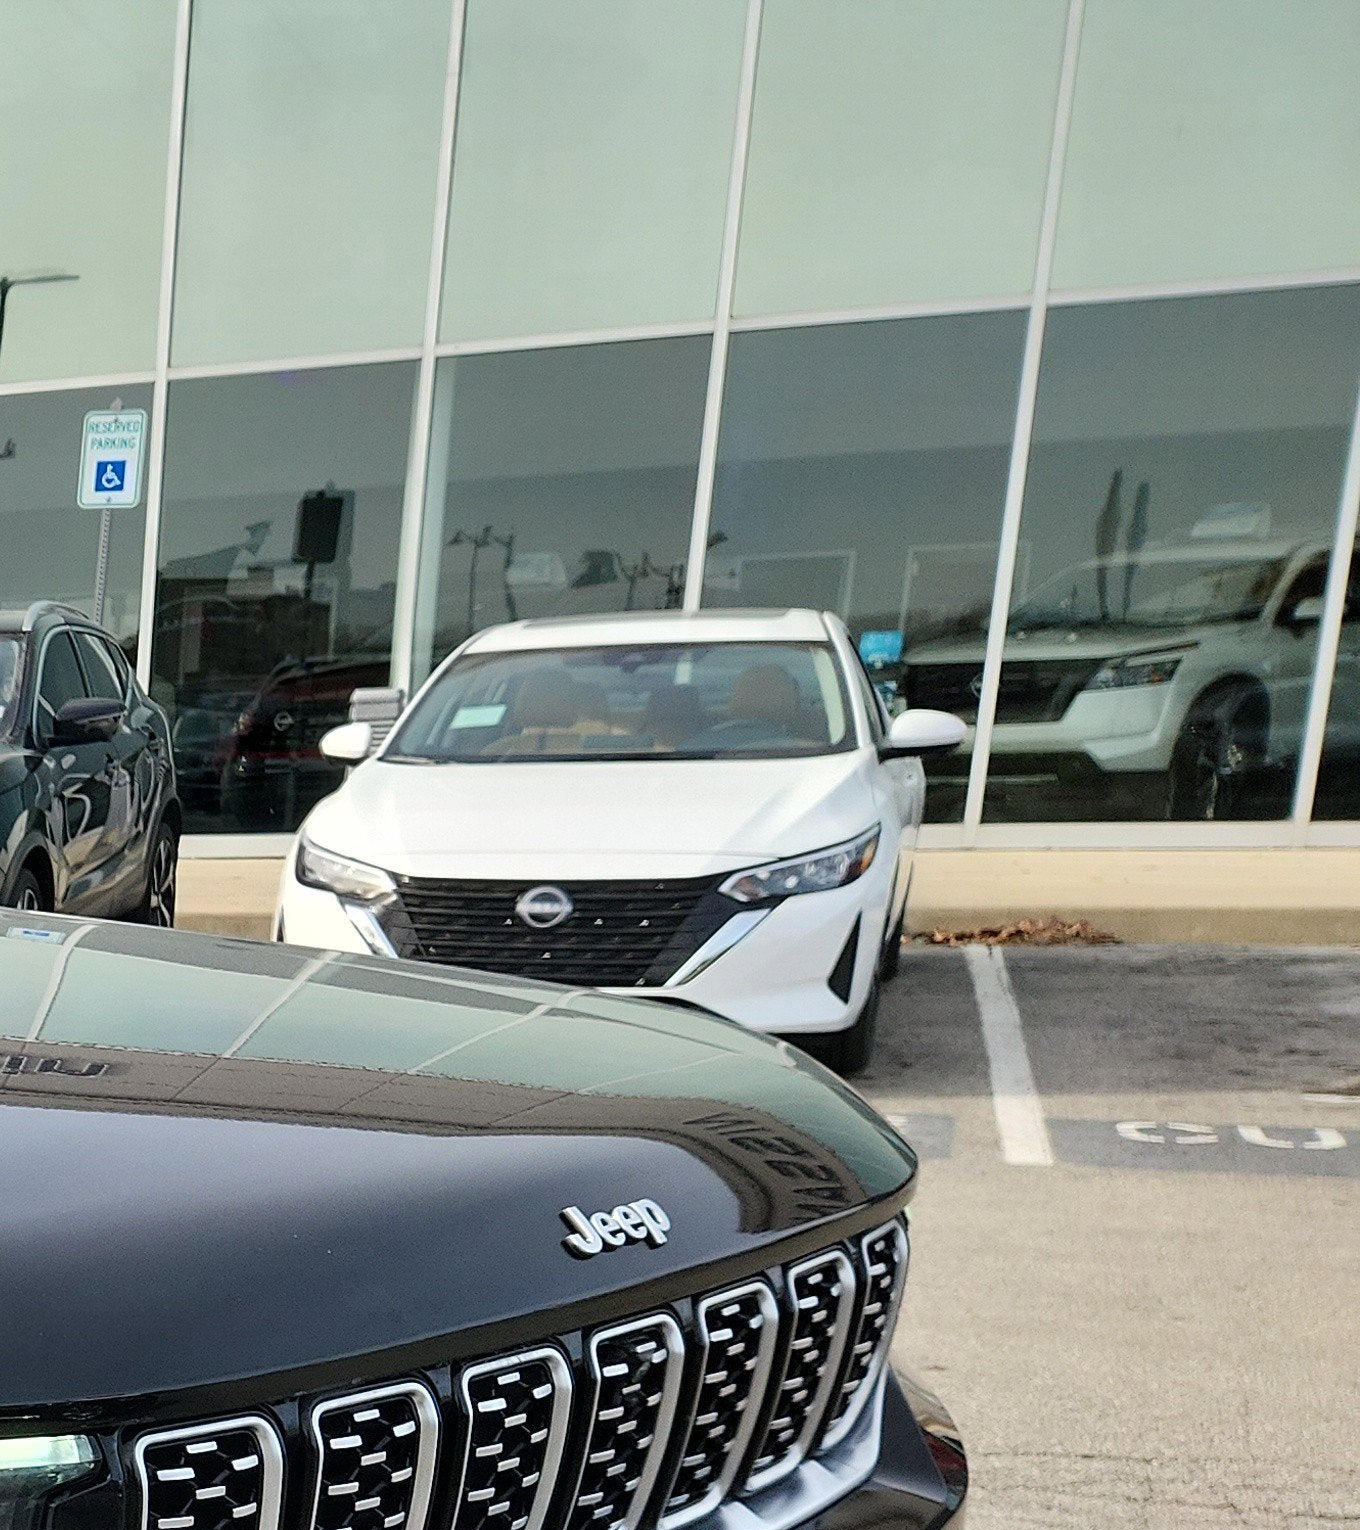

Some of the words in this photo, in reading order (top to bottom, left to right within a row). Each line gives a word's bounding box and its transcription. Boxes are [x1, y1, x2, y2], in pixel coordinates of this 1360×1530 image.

[87, 421, 140, 434] RESERVED
[90, 437, 136, 450] PARKING
[561, 1198, 671, 1256] Jeep
